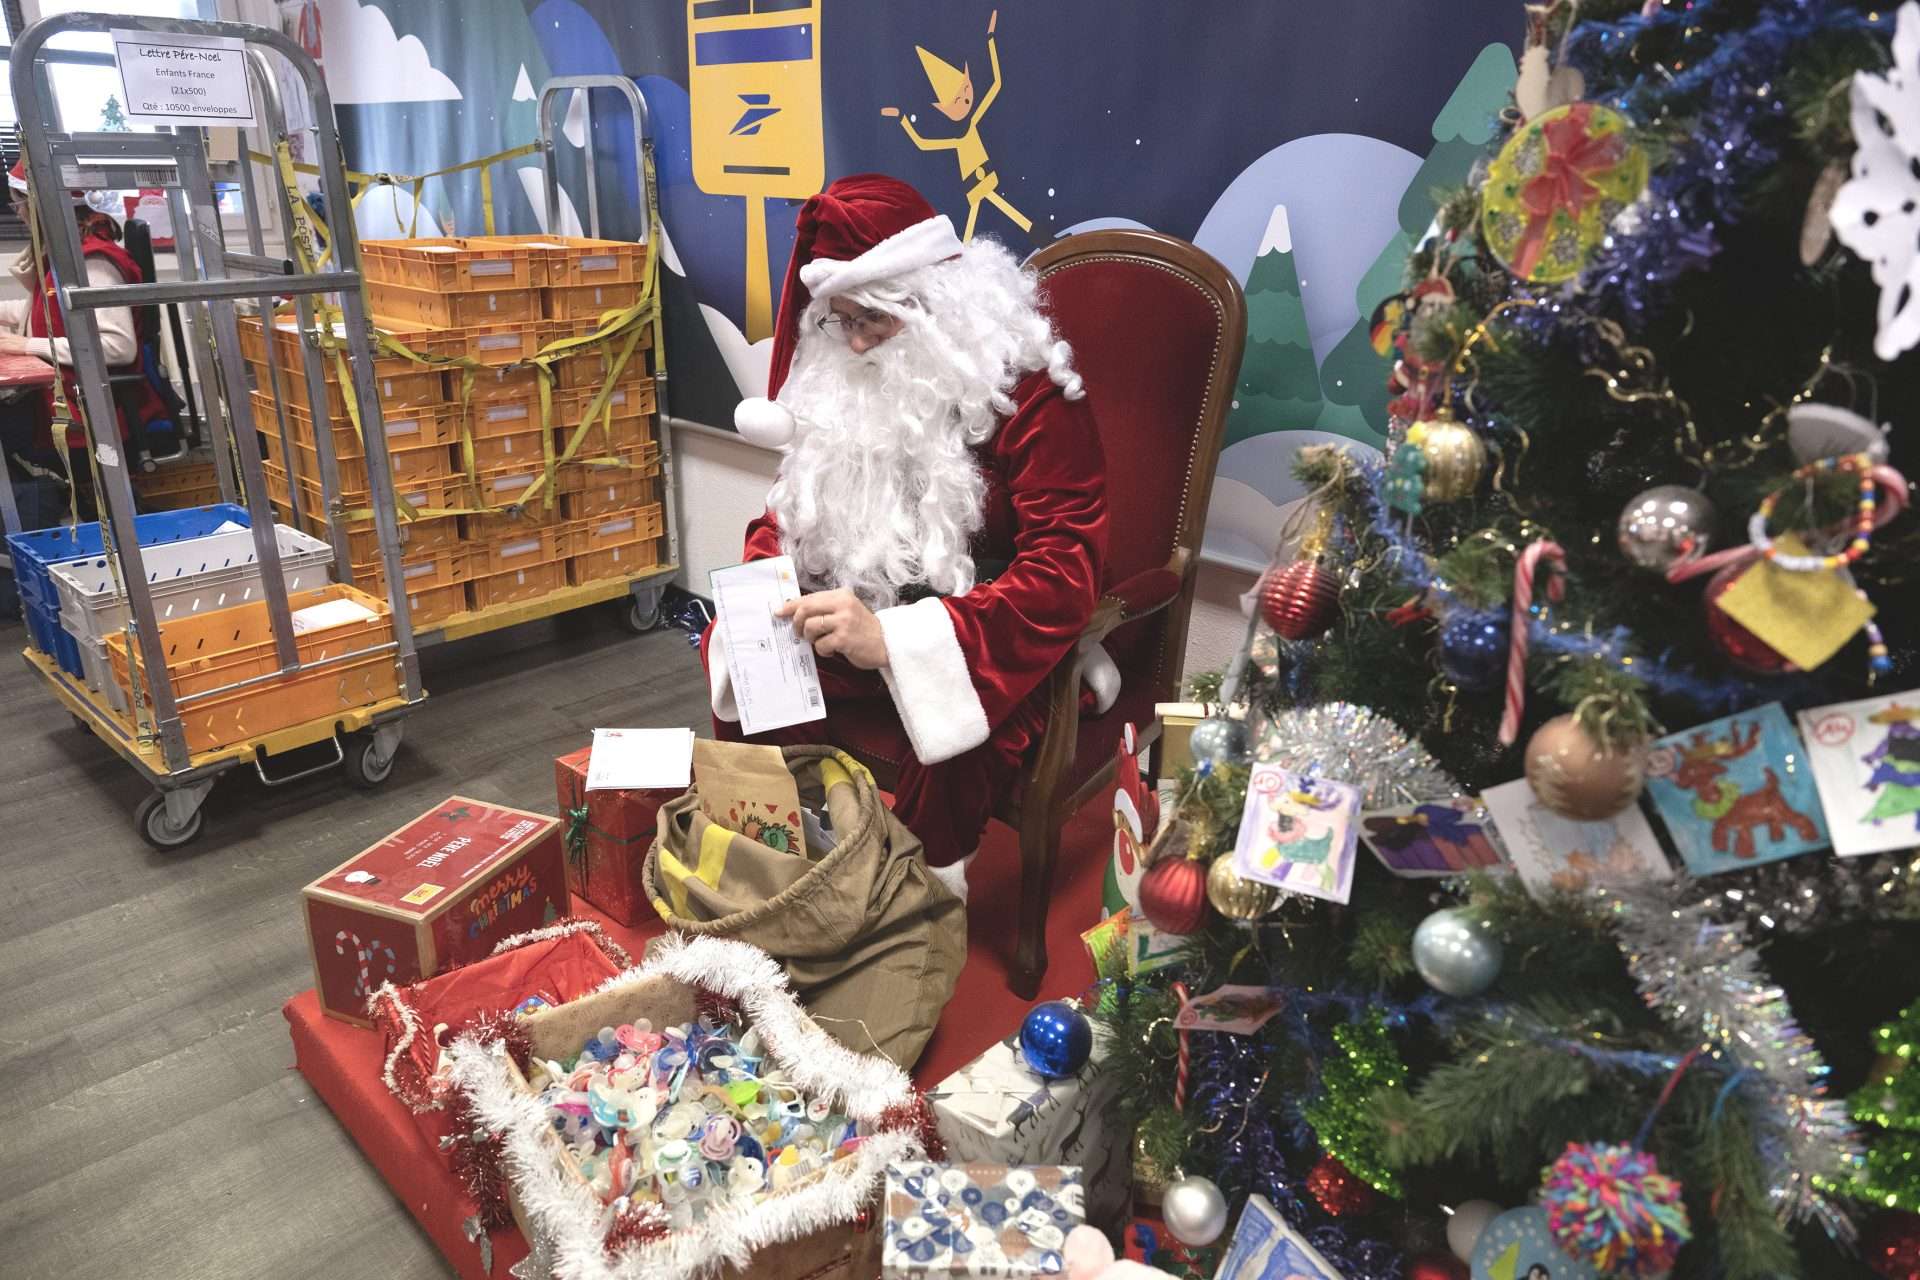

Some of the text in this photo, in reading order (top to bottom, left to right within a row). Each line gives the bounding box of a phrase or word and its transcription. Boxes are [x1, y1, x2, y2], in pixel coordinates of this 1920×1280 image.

[139, 47, 171, 59] Lettre
[155, 68, 216, 79] Enfants France
[171, 86, 207, 97] (21x500)
[165, 103, 191, 112] 10500
[192, 105, 238, 114] enveloppes
[287, 185, 300, 204] LA
